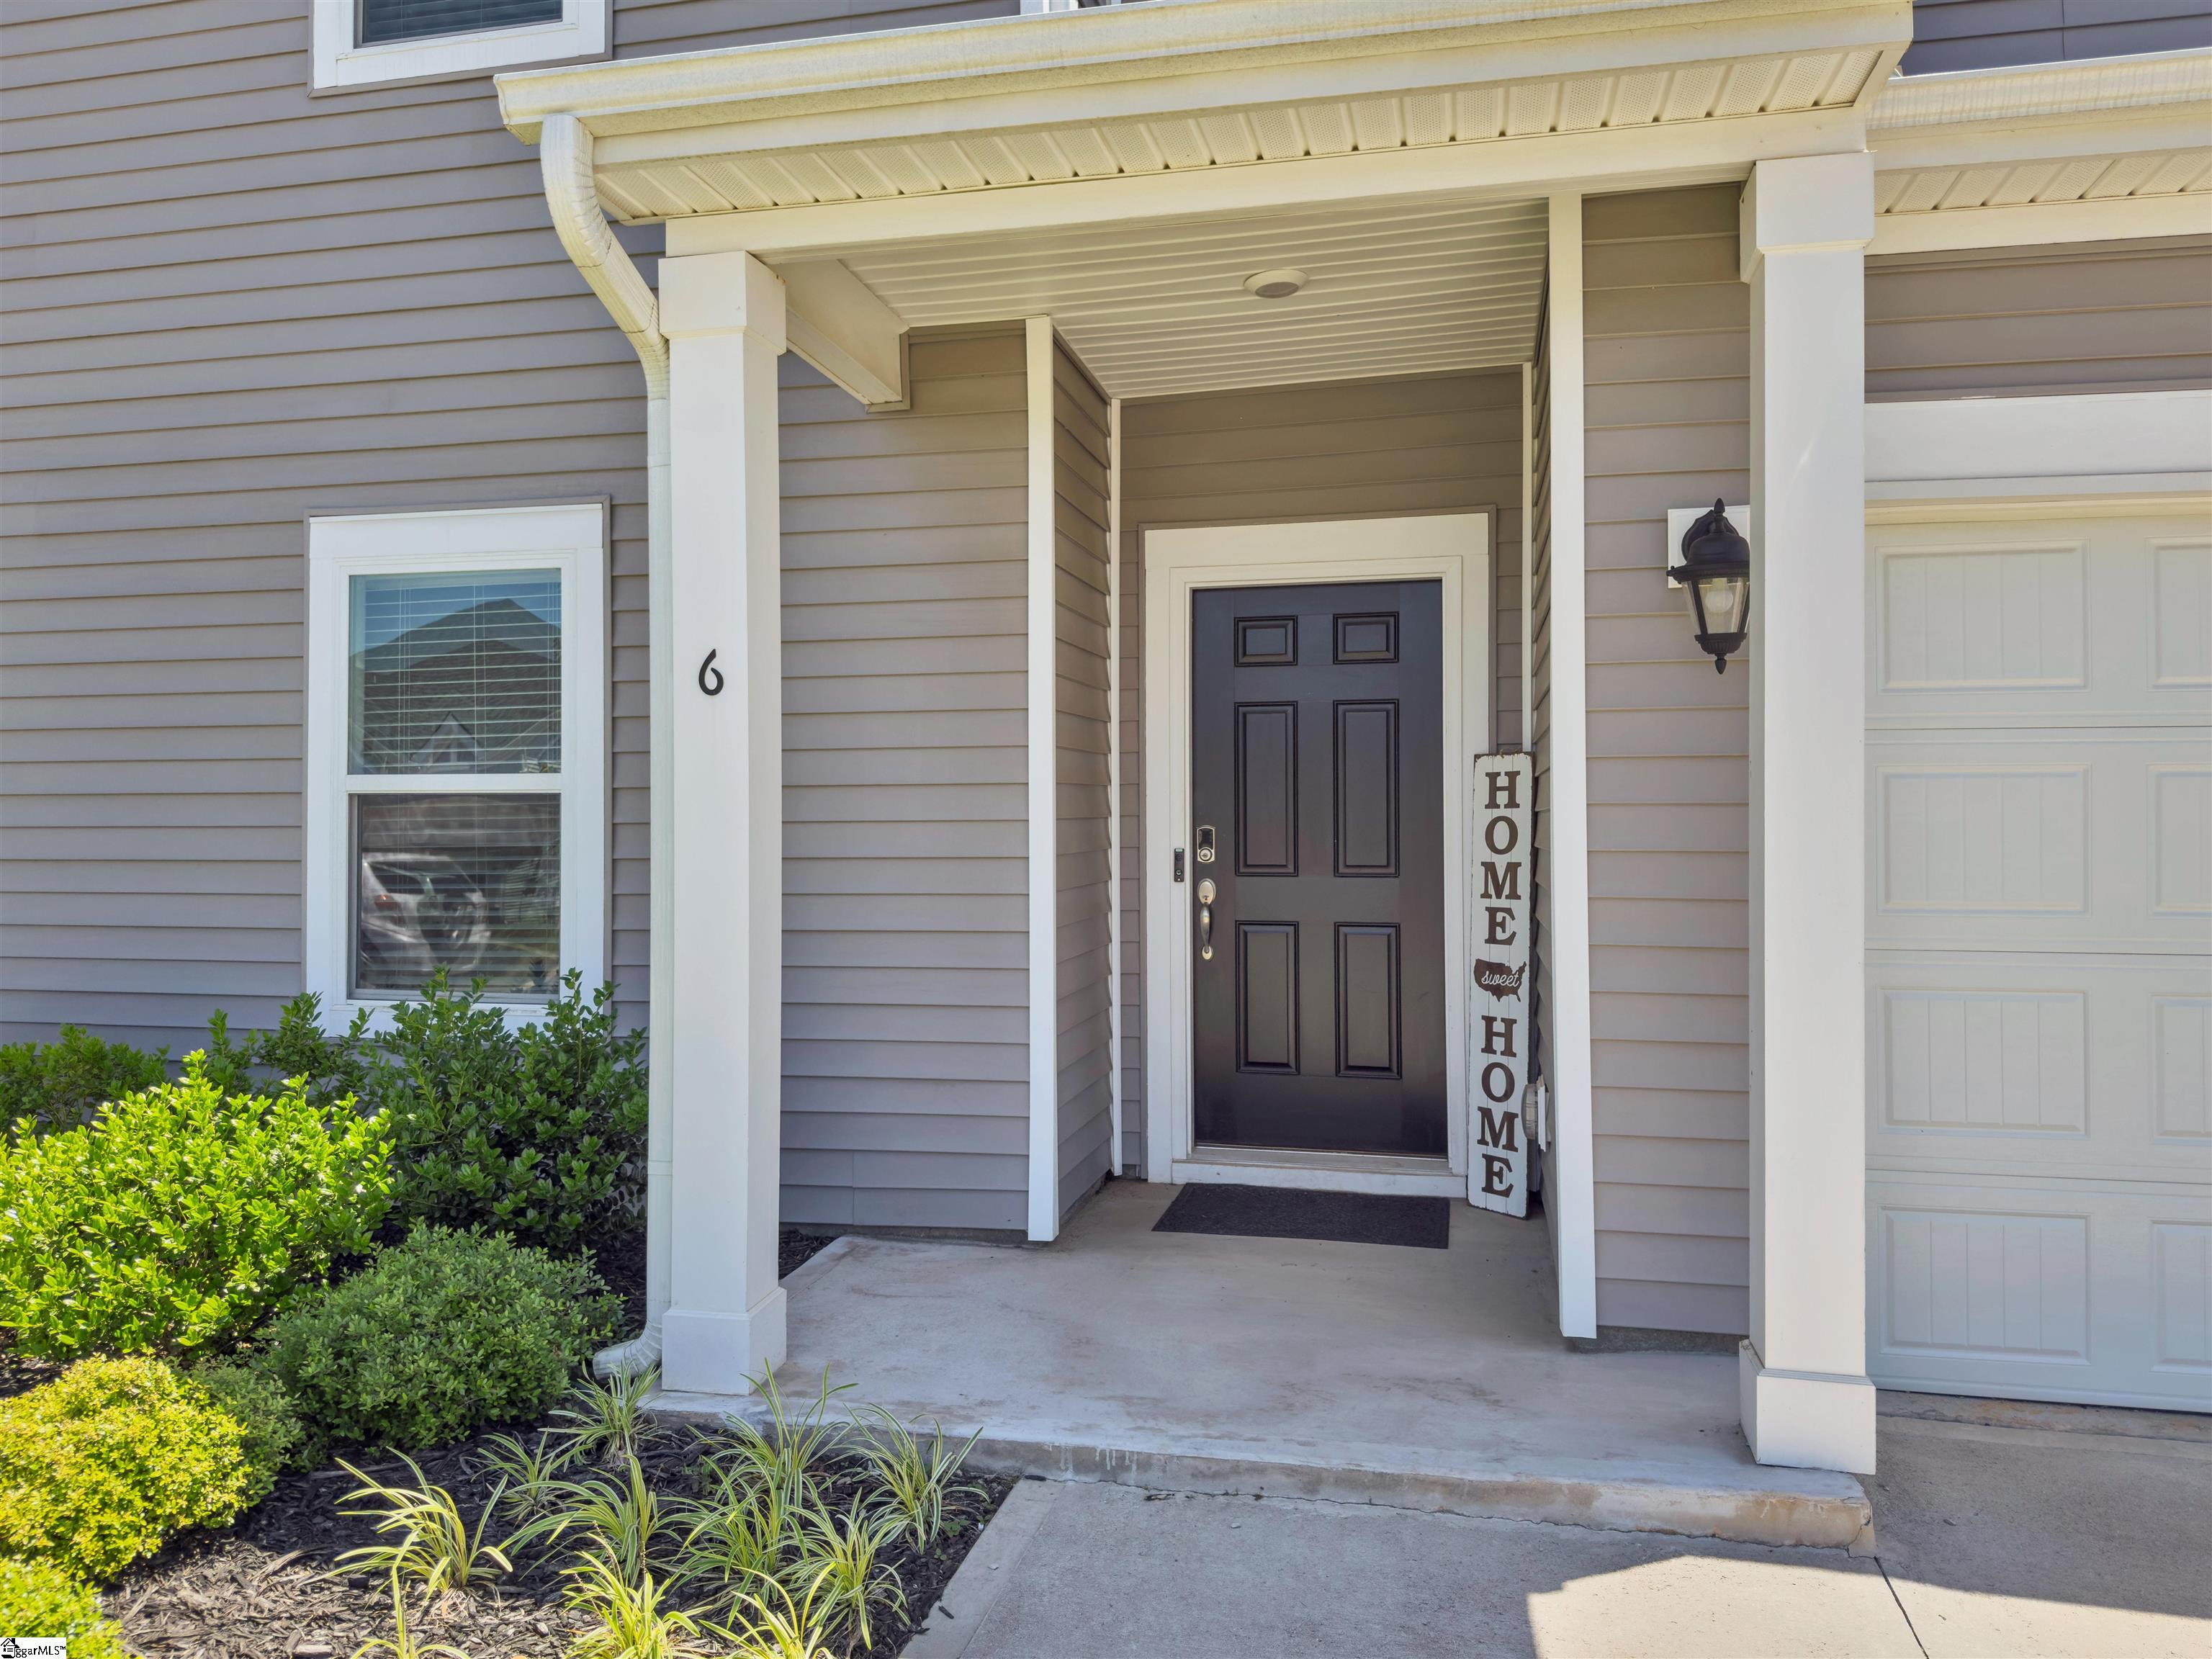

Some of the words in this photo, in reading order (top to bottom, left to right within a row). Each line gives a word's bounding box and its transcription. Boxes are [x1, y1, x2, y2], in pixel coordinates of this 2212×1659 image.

[698, 648, 724, 696] 6
[1480, 770, 1522, 945] HOME
[1481, 970, 1520, 987] sweet
[1477, 1015, 1519, 1198] HOME
